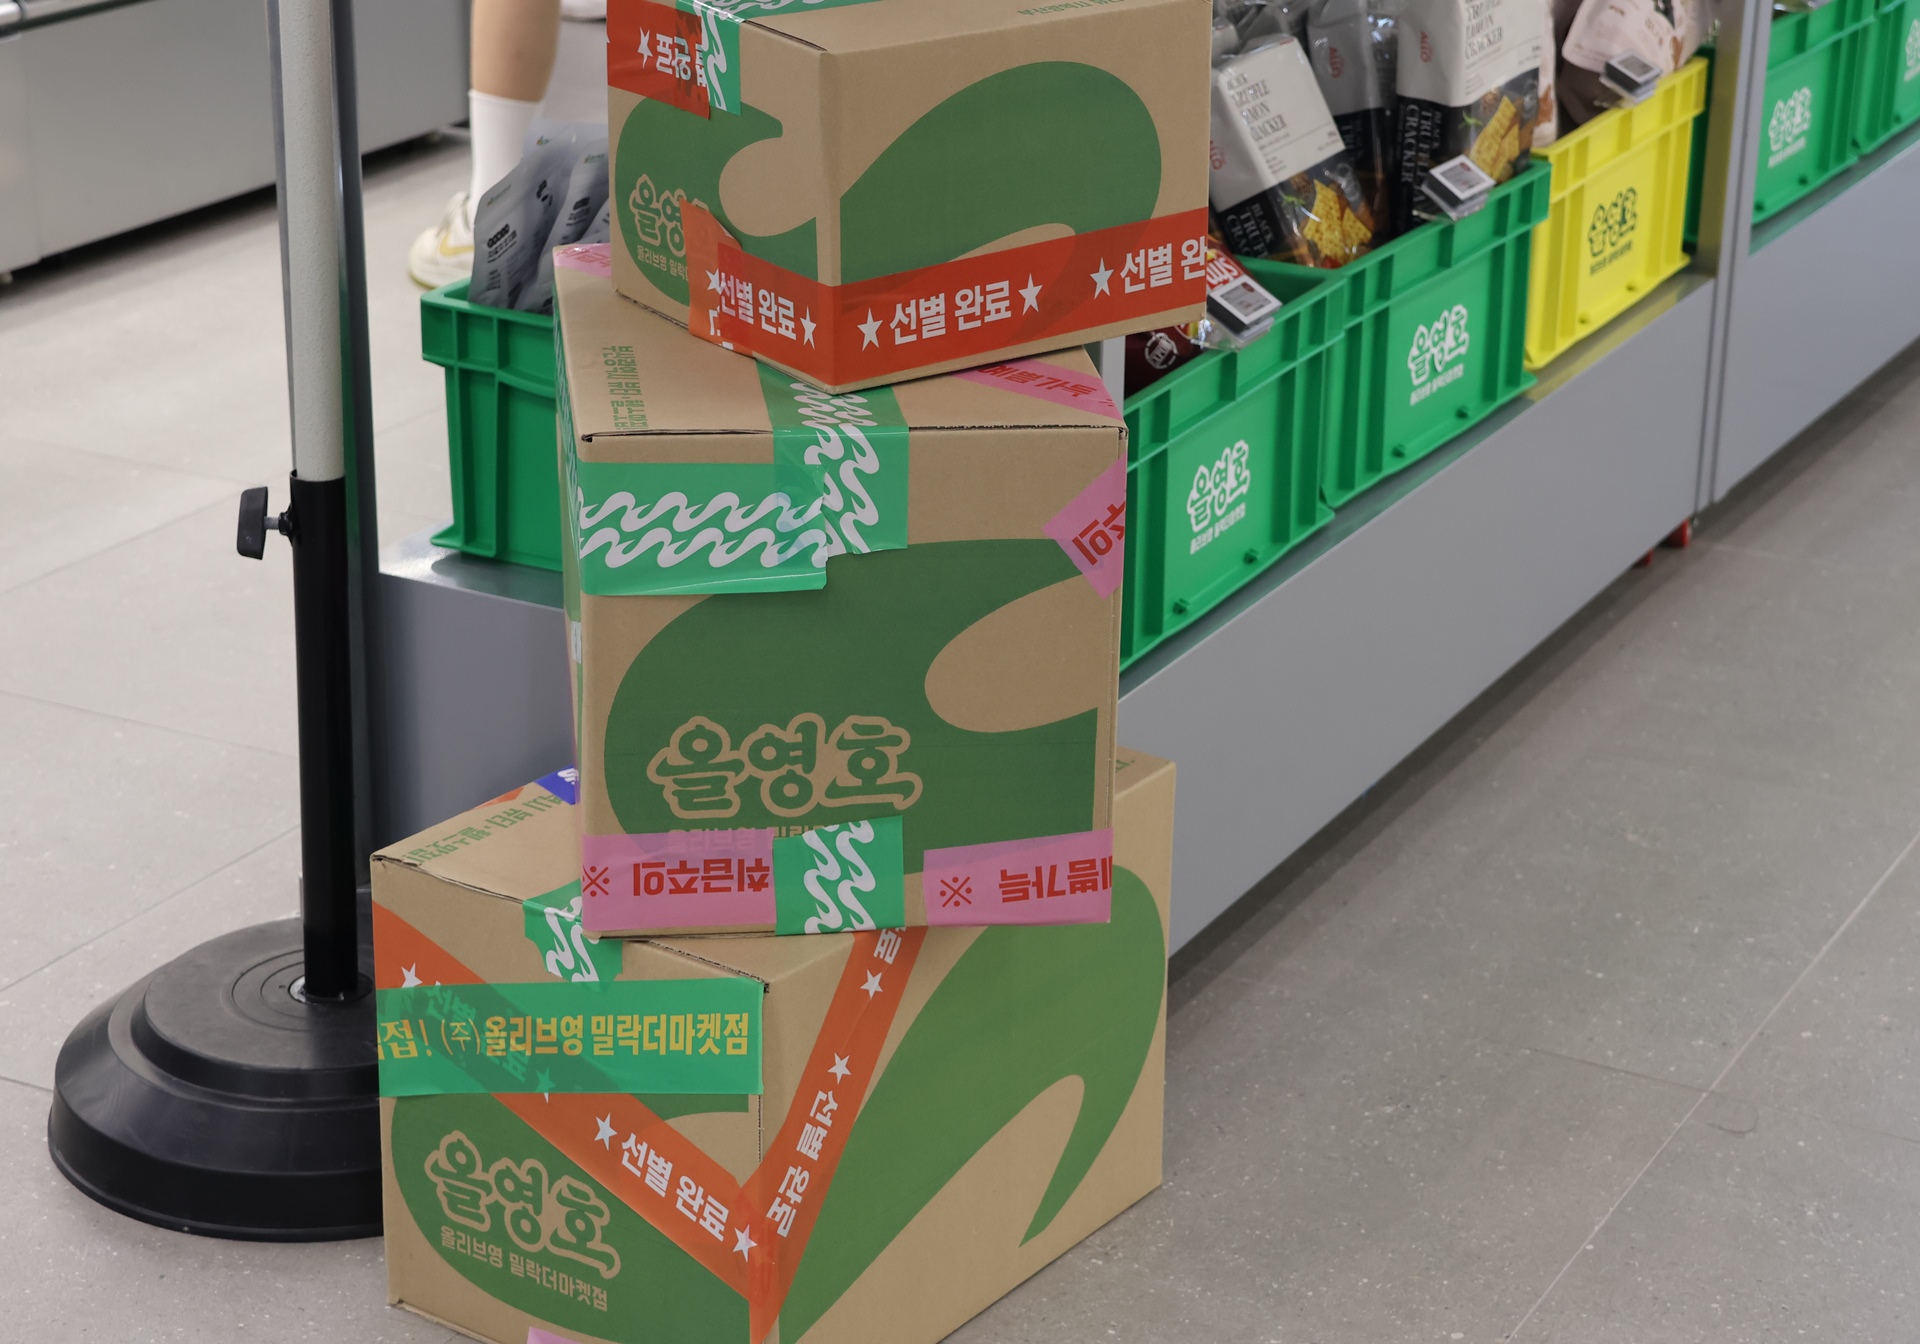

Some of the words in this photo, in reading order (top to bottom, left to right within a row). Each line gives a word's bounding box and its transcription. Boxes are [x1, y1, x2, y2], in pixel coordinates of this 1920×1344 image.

[637, 244, 667, 272] 올리브영
[1119, 243, 1173, 294] 선별
[757, 288, 797, 341] 완료
[889, 292, 946, 346] 선별
[954, 280, 1012, 332] 완료
[632, 857, 770, 897] 취급주의
[591, 1012, 749, 1056] 밀락더마켓점
[796, 1090, 839, 1161] 선별
[621, 1132, 673, 1198] 선별
[675, 1175, 729, 1242] 완료
[766, 1165, 810, 1238] 완료
[441, 1225, 503, 1268] 올리브영
[509, 1252, 608, 1312] 밀락더마켓점
